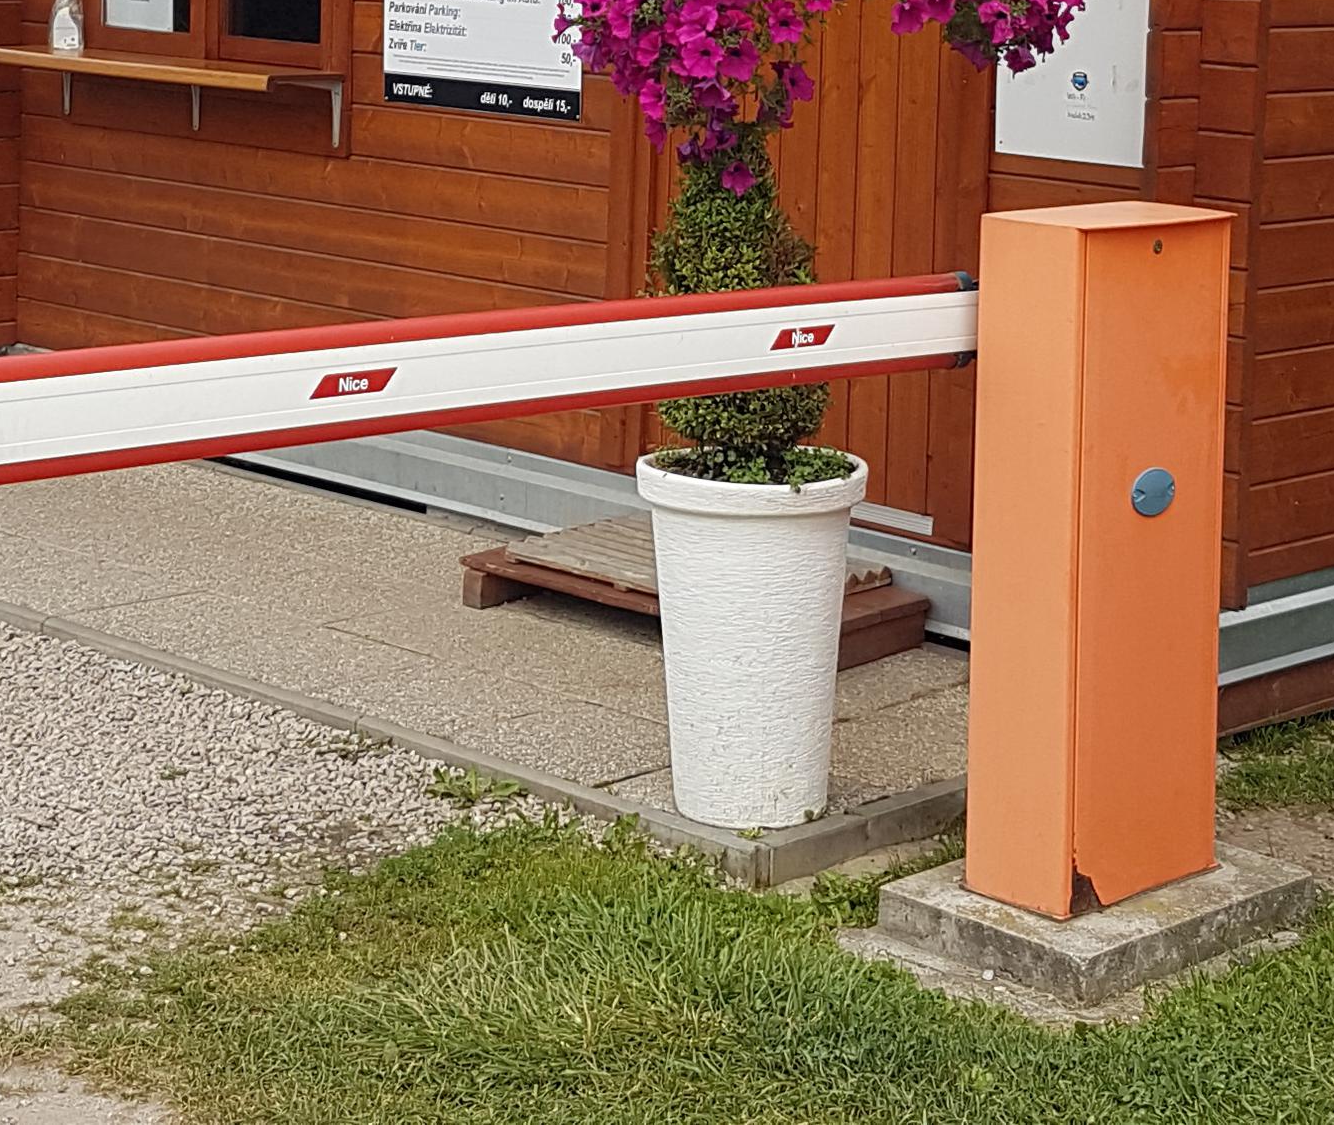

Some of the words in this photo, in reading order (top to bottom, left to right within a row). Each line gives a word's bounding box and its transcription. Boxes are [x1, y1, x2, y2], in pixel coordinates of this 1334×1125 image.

[389, 1, 427, 15] Parkování
[429, 4, 461, 20] Parking:
[561, 52, 576, 67] 50,-
[498, 94, 513, 108] 10,-
[556, 100, 571, 114] 15,-
[791, 331, 815, 345] Nice
[338, 376, 369, 393] Nice
